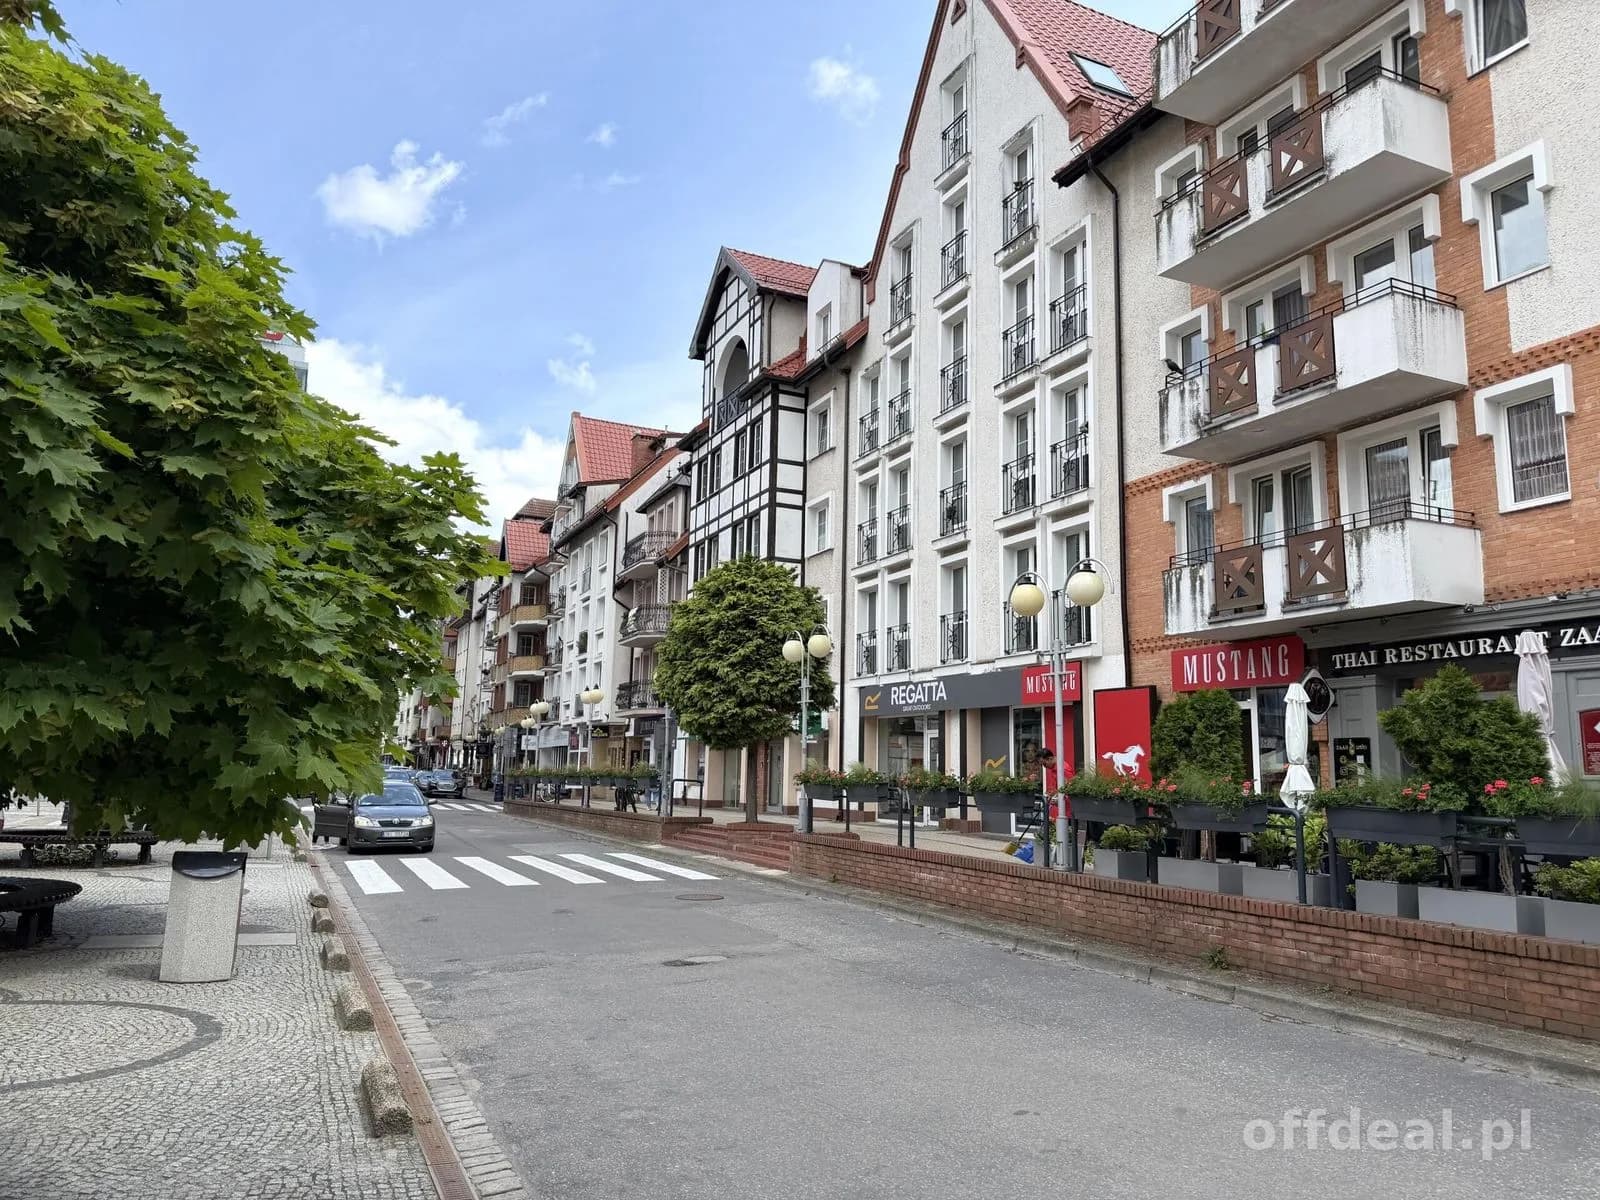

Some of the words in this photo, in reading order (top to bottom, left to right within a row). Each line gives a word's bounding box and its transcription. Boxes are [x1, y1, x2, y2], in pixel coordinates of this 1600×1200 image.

[1183, 644, 1289, 685] MUSTANG
[1332, 650, 1377, 669] THAI
[1384, 631, 1549, 664] RESTAURAT
[890, 681, 947, 706] REGATTA
[1026, 673, 1076, 694] MUSTNG
